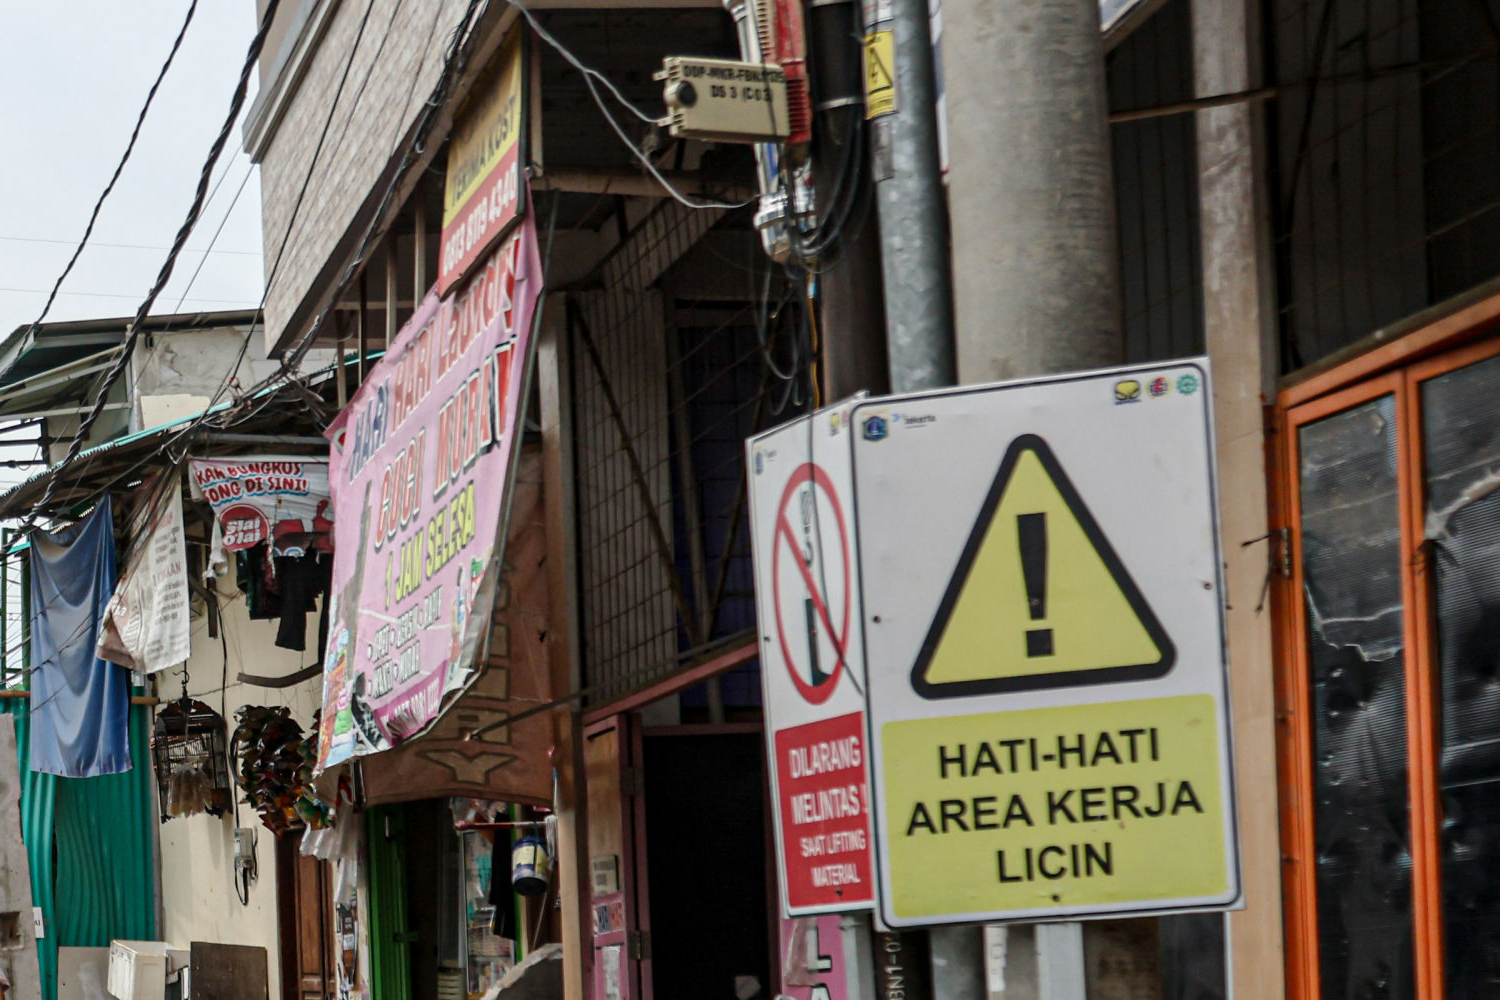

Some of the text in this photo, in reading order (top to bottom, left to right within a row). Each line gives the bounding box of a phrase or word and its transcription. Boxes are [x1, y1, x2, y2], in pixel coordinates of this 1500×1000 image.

[245, 476, 263, 493] DI
[268, 476, 308, 493] SINI!
[396, 526, 423, 604] JAM
[789, 735, 861, 778] DILARANG
[939, 727, 1160, 779] HATI-HATI
[791, 784, 860, 824] MELINTAS
[906, 781, 1204, 836] AREA KERJA
[801, 835, 826, 857] SAAT
[997, 842, 1113, 884] LICIN
[811, 863, 861, 887] MATERIAL
